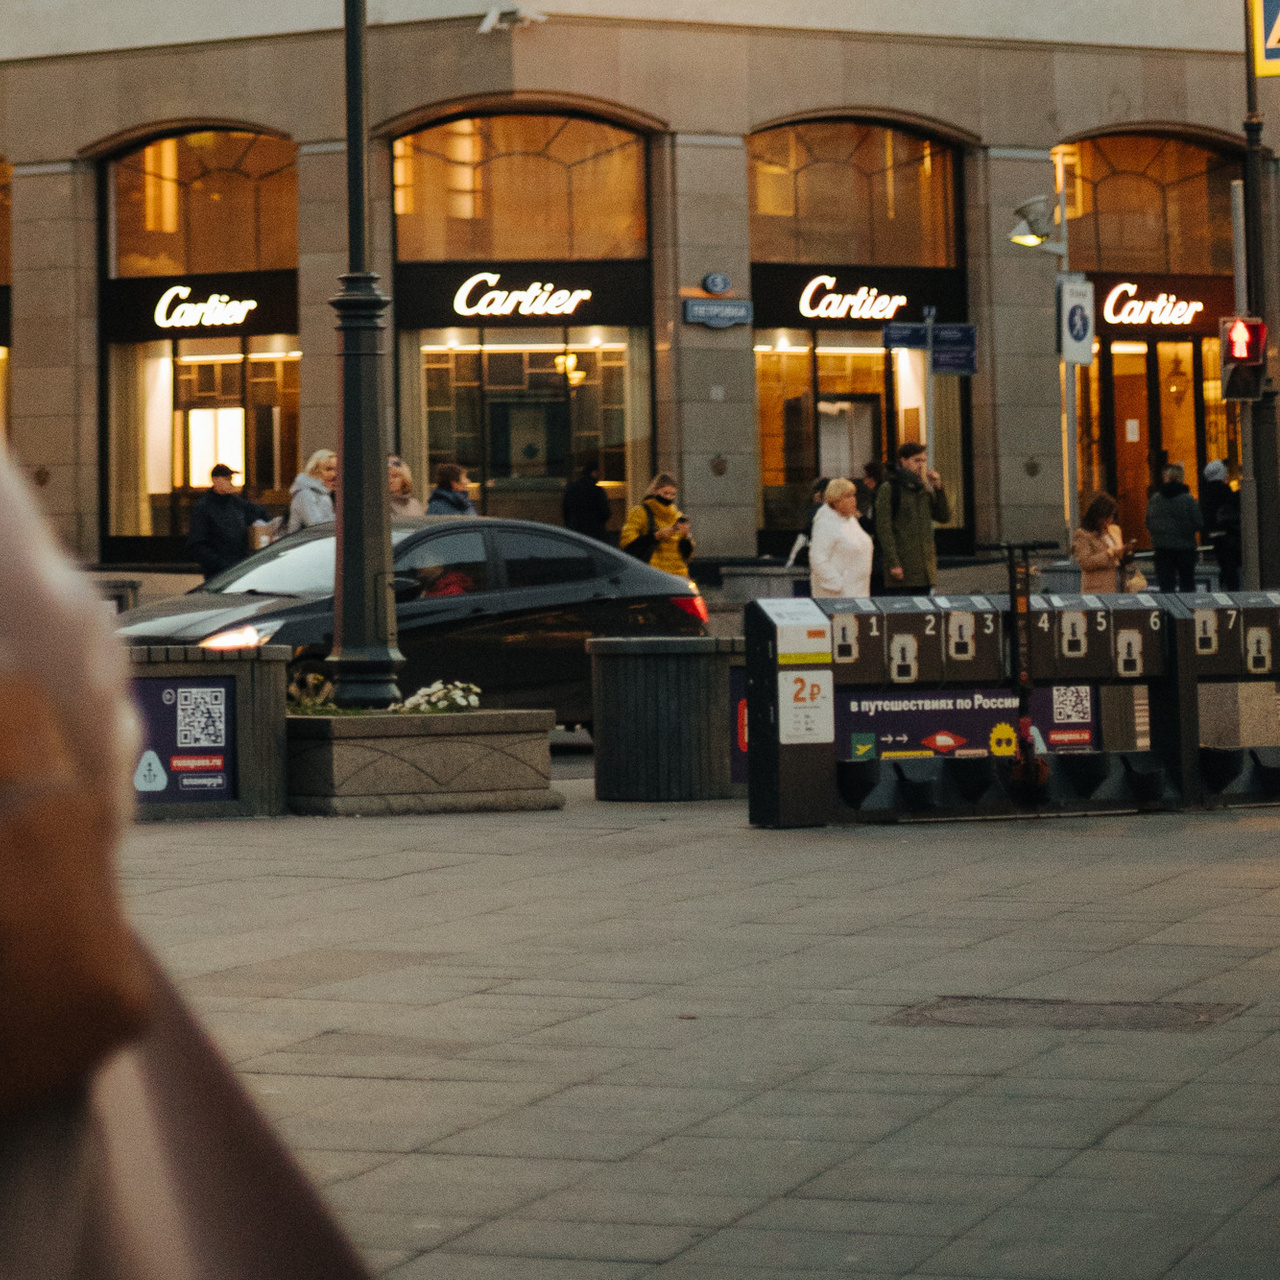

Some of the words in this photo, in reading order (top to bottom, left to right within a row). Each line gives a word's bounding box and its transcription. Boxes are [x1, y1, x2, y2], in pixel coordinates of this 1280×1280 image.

[454, 273, 592, 316] Cartier
[799, 275, 907, 319] Cartier
[1103, 282, 1204, 325] Cartier
[154, 285, 257, 328] Cartier
[869, 616, 880, 636] 1
[925, 615, 936, 636] 2
[984, 614, 994, 635] 3
[1038, 613, 1051, 632] 4
[1097, 611, 1107, 632] 5
[1150, 611, 1161, 631] 6
[1227, 610, 1237, 629] 7
[850, 702, 859, 712] в
[861, 699, 954, 716] путешествиях
[956, 699, 972, 710] по
